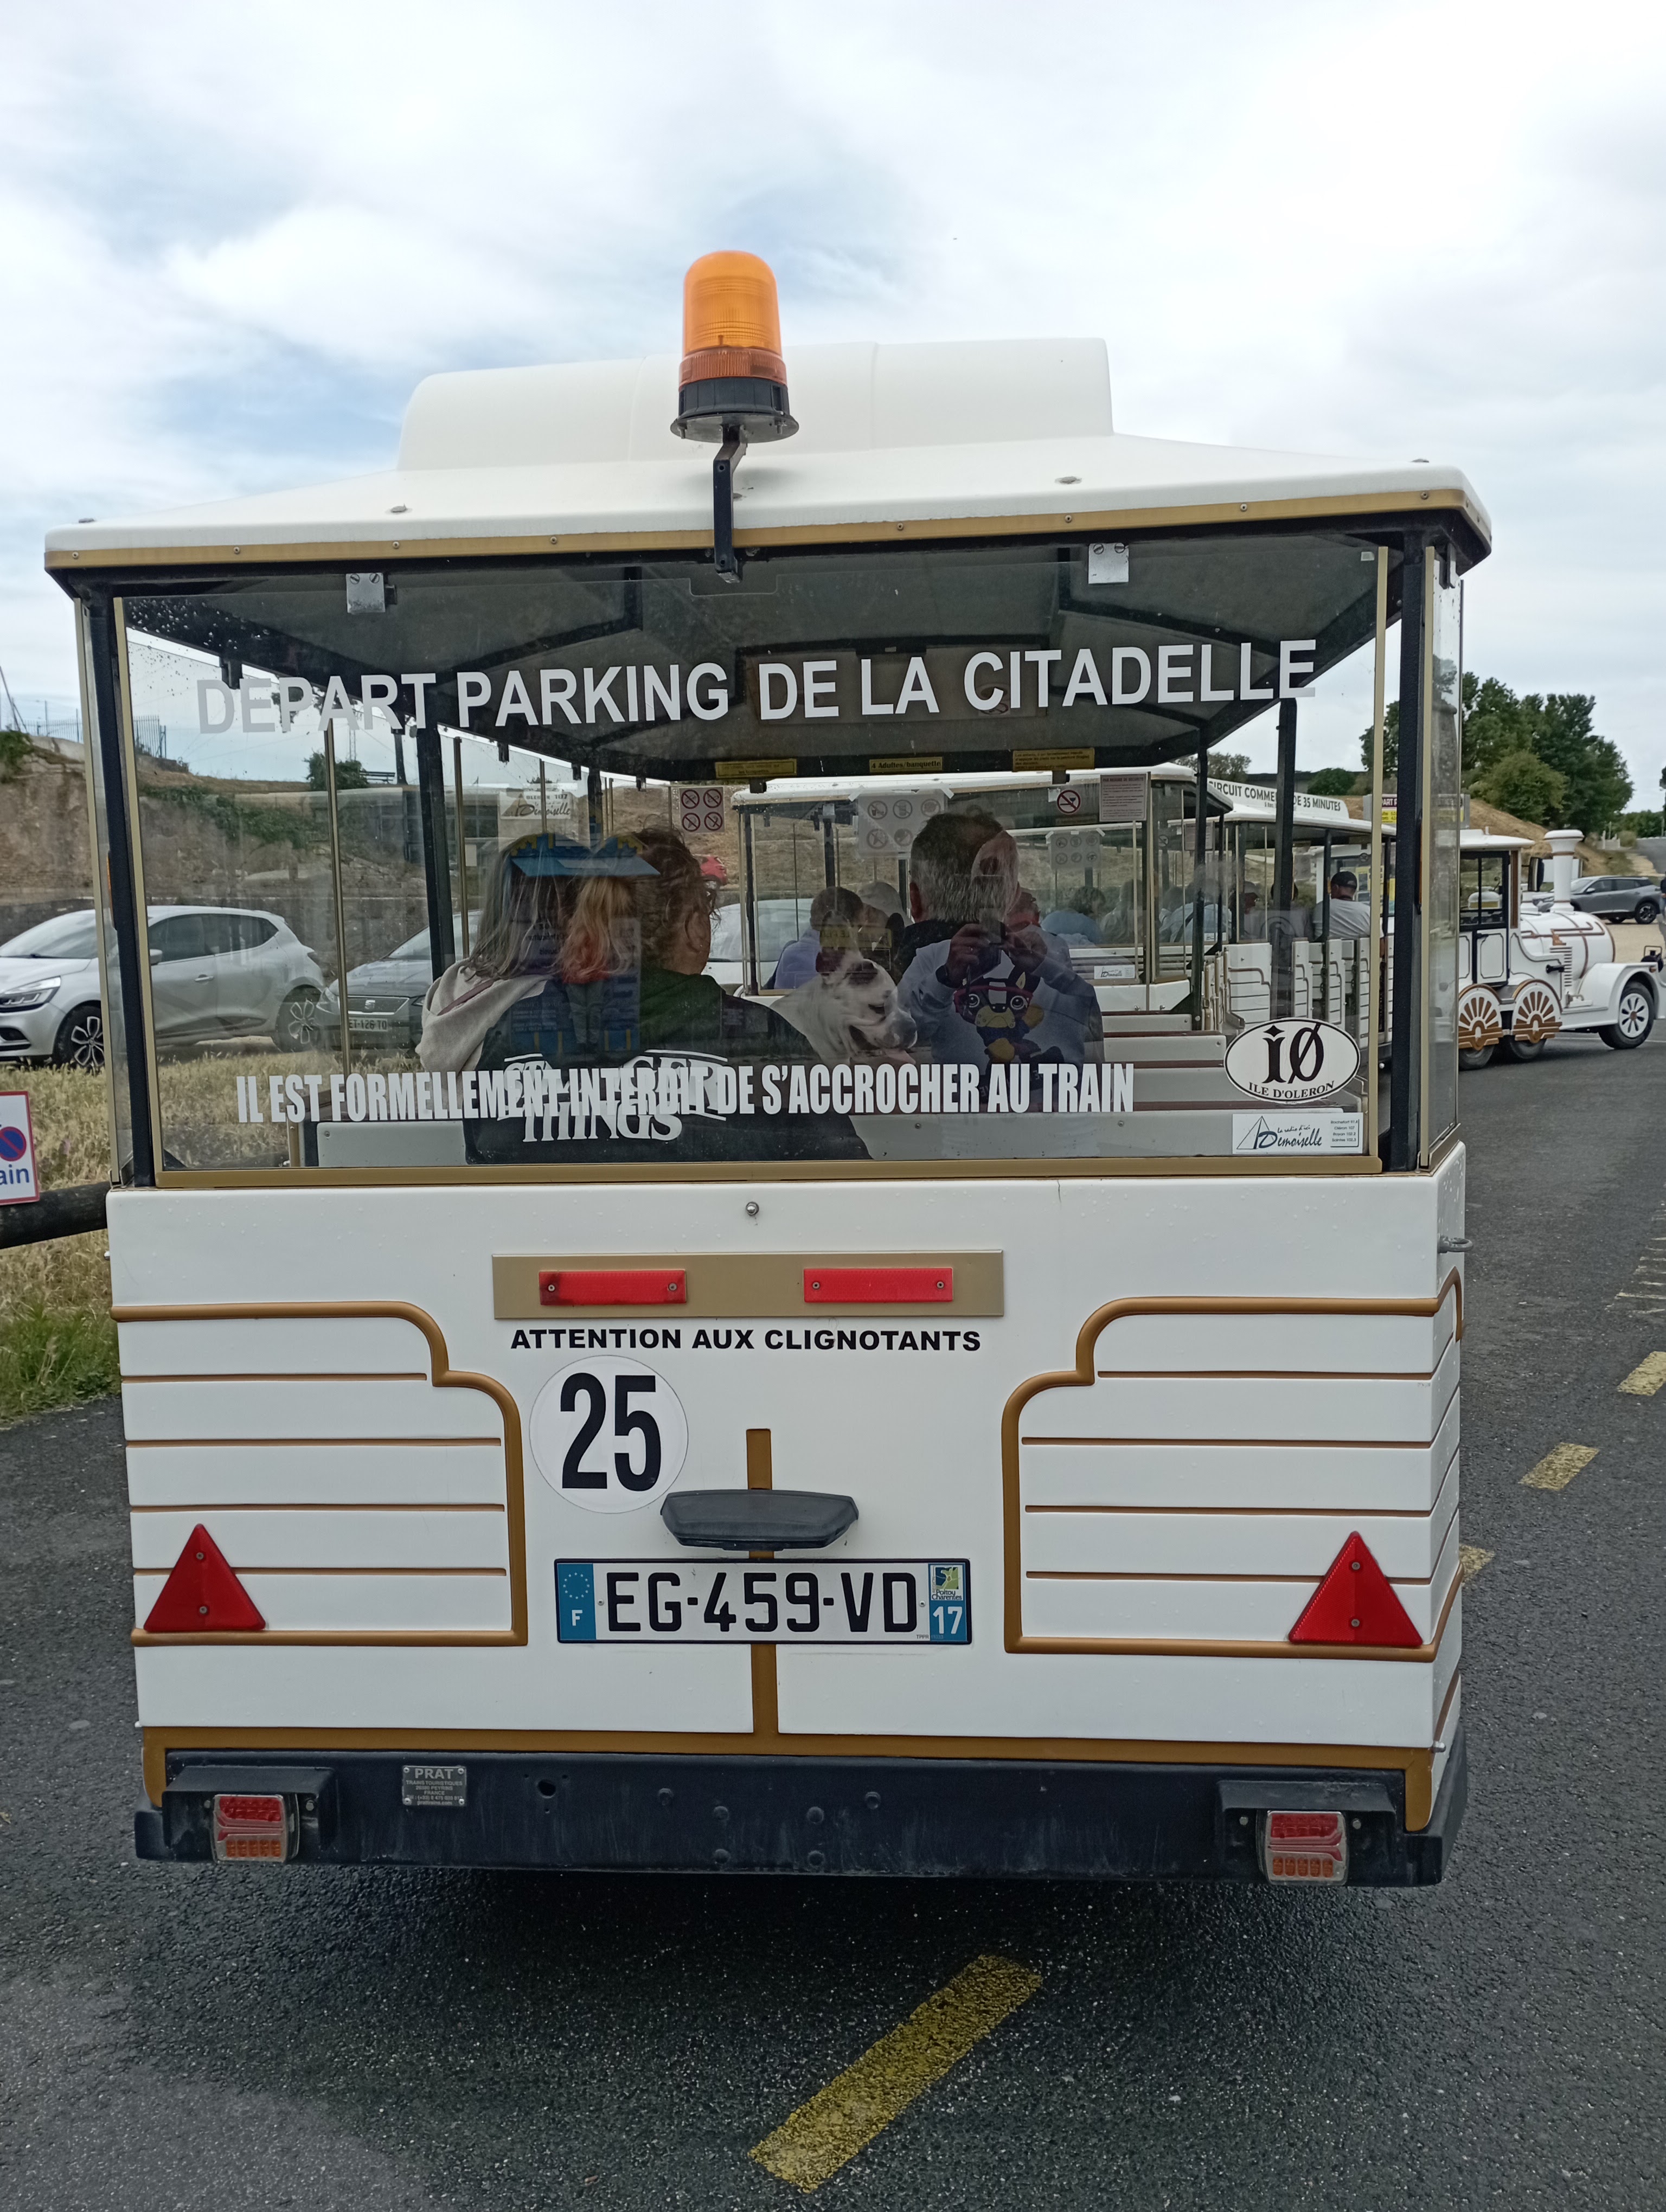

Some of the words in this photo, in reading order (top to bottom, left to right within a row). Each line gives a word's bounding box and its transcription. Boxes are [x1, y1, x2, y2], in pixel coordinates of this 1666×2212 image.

[197, 672, 436, 734] DEPART
[457, 662, 728, 728] PARKING
[759, 660, 839, 721] DE
[861, 657, 939, 715] LA
[964, 639, 1316, 710] CITADELLE
[1209, 781, 1242, 796] IRCUIT
[1245, 787, 1275, 802] COMME
[1303, 797, 1311, 808] 35
[1312, 798, 1341, 811] MINUTES
[236, 1075, 264, 1123] IL
[268, 1074, 322, 1123] EST
[330, 1069, 561, 1122] FORMELLEMENT
[569, 1066, 708, 1117] INTERDIT
[717, 1065, 755, 1115] DE
[987, 1063, 1030, 1114] AU
[1038, 1063, 1134, 1113] TRAIN
[1248, 1082, 1269, 1096] ILE
[1273, 1081, 1335, 1099] D'OLERON
[511, 1329, 682, 1349] ATTENTION
[692, 1329, 754, 1349] AUX
[765, 1329, 982, 1352] CLIGNOTANTS
[560, 1372, 662, 1492] 25
[606, 1572, 917, 1632] EG-459-VD
[572, 1610, 584, 1626] F
[933, 1606, 963, 1634] 17
[415, 1768, 454, 1779] PRAT
